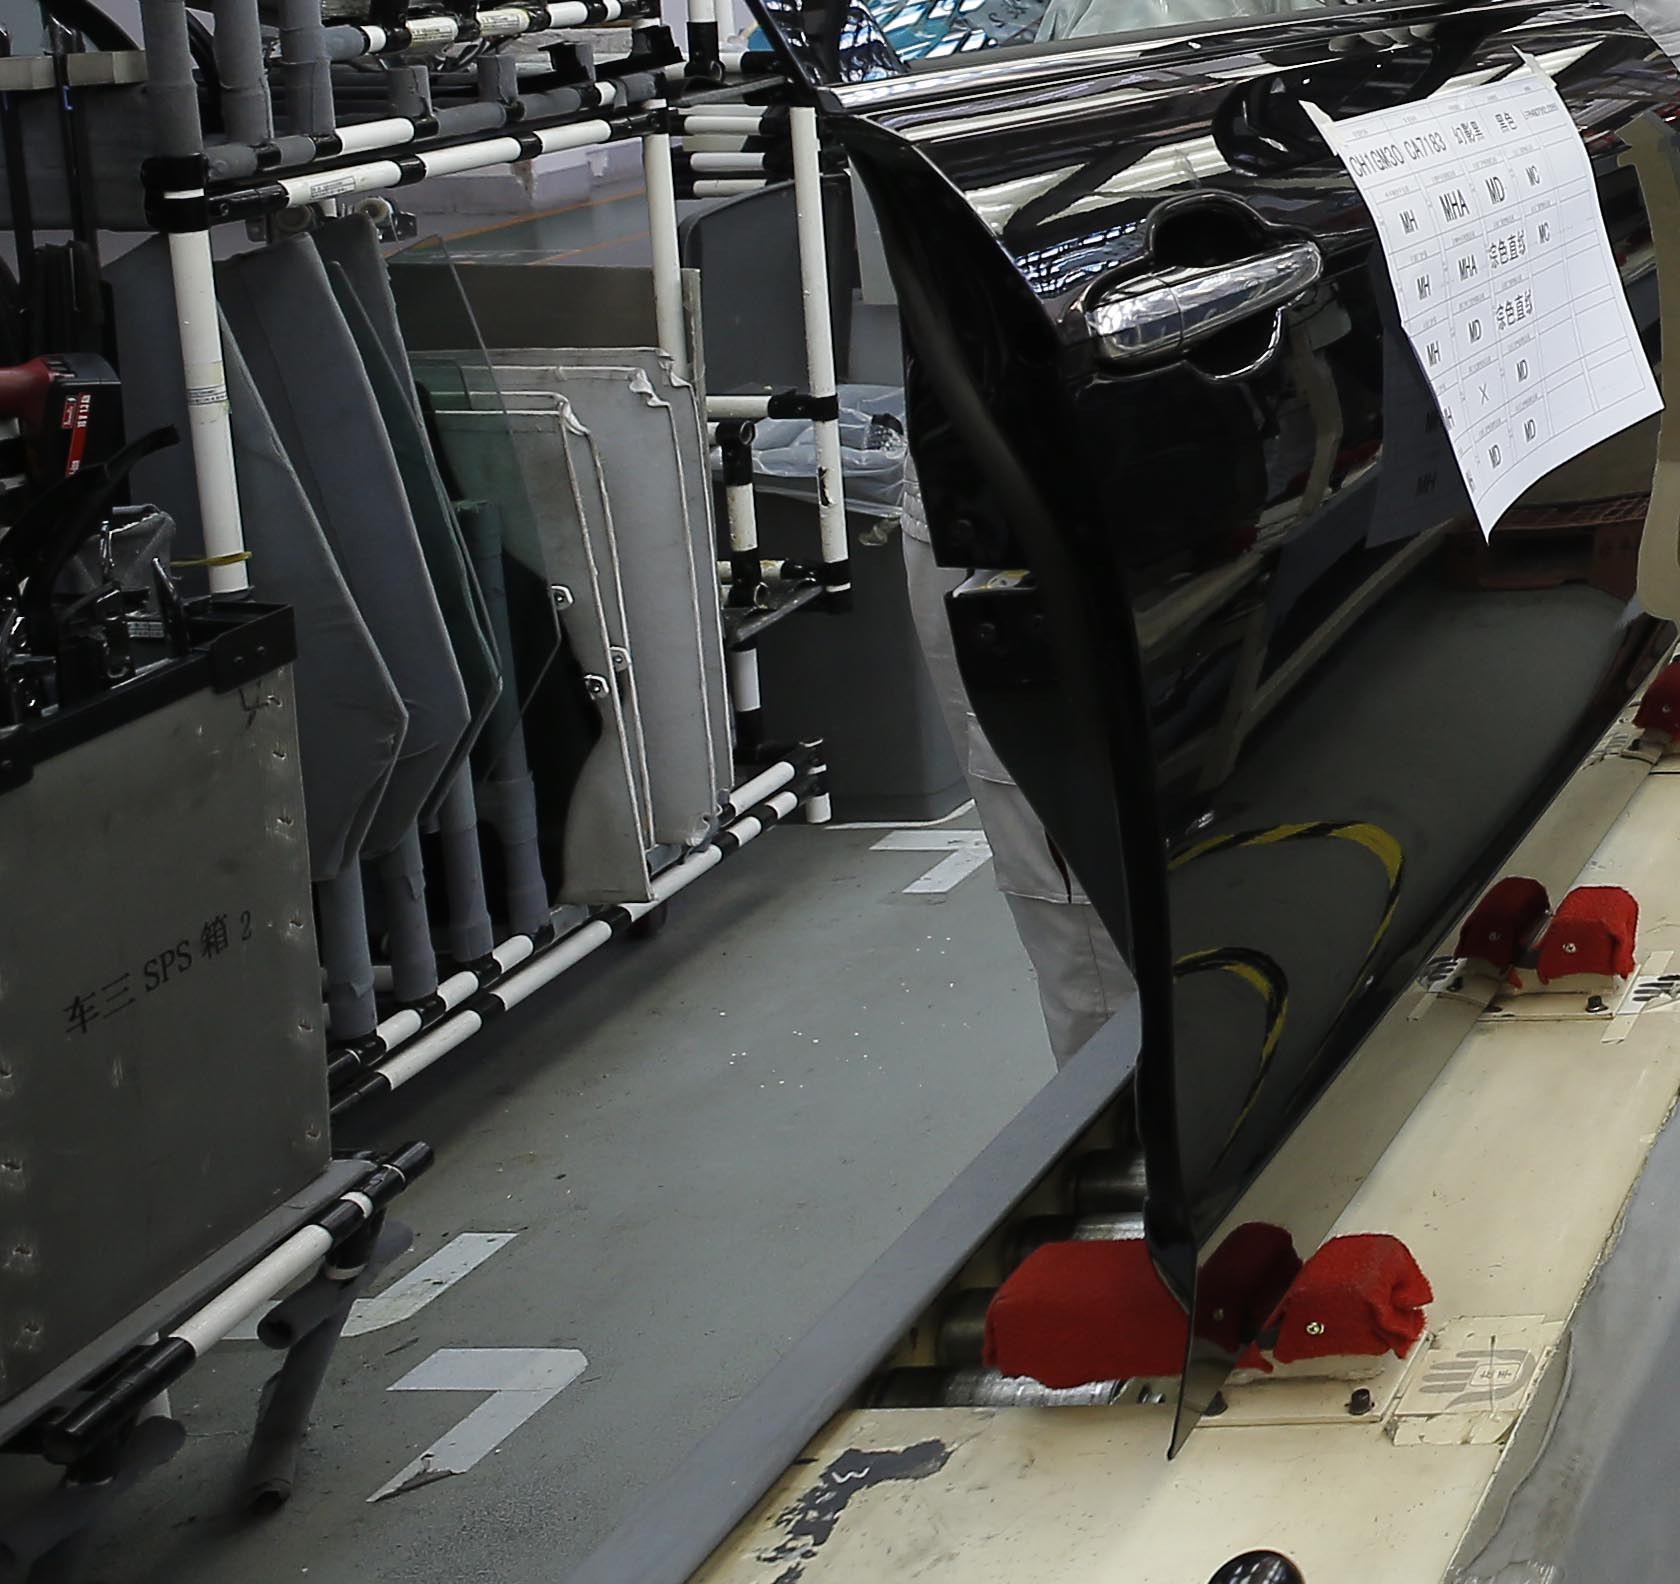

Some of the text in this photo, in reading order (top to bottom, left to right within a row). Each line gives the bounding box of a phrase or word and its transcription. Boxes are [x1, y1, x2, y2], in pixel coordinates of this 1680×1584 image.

[1439, 189, 1471, 223] MHA
[1485, 176, 1506, 205] MD
[1458, 254, 1478, 281] MHA
[1468, 319, 1482, 344] MD
[1516, 359, 1530, 383] MD
[1488, 418, 1537, 469] MD MD
[63, 909, 255, 1036] 车三 SPS 箱 2
